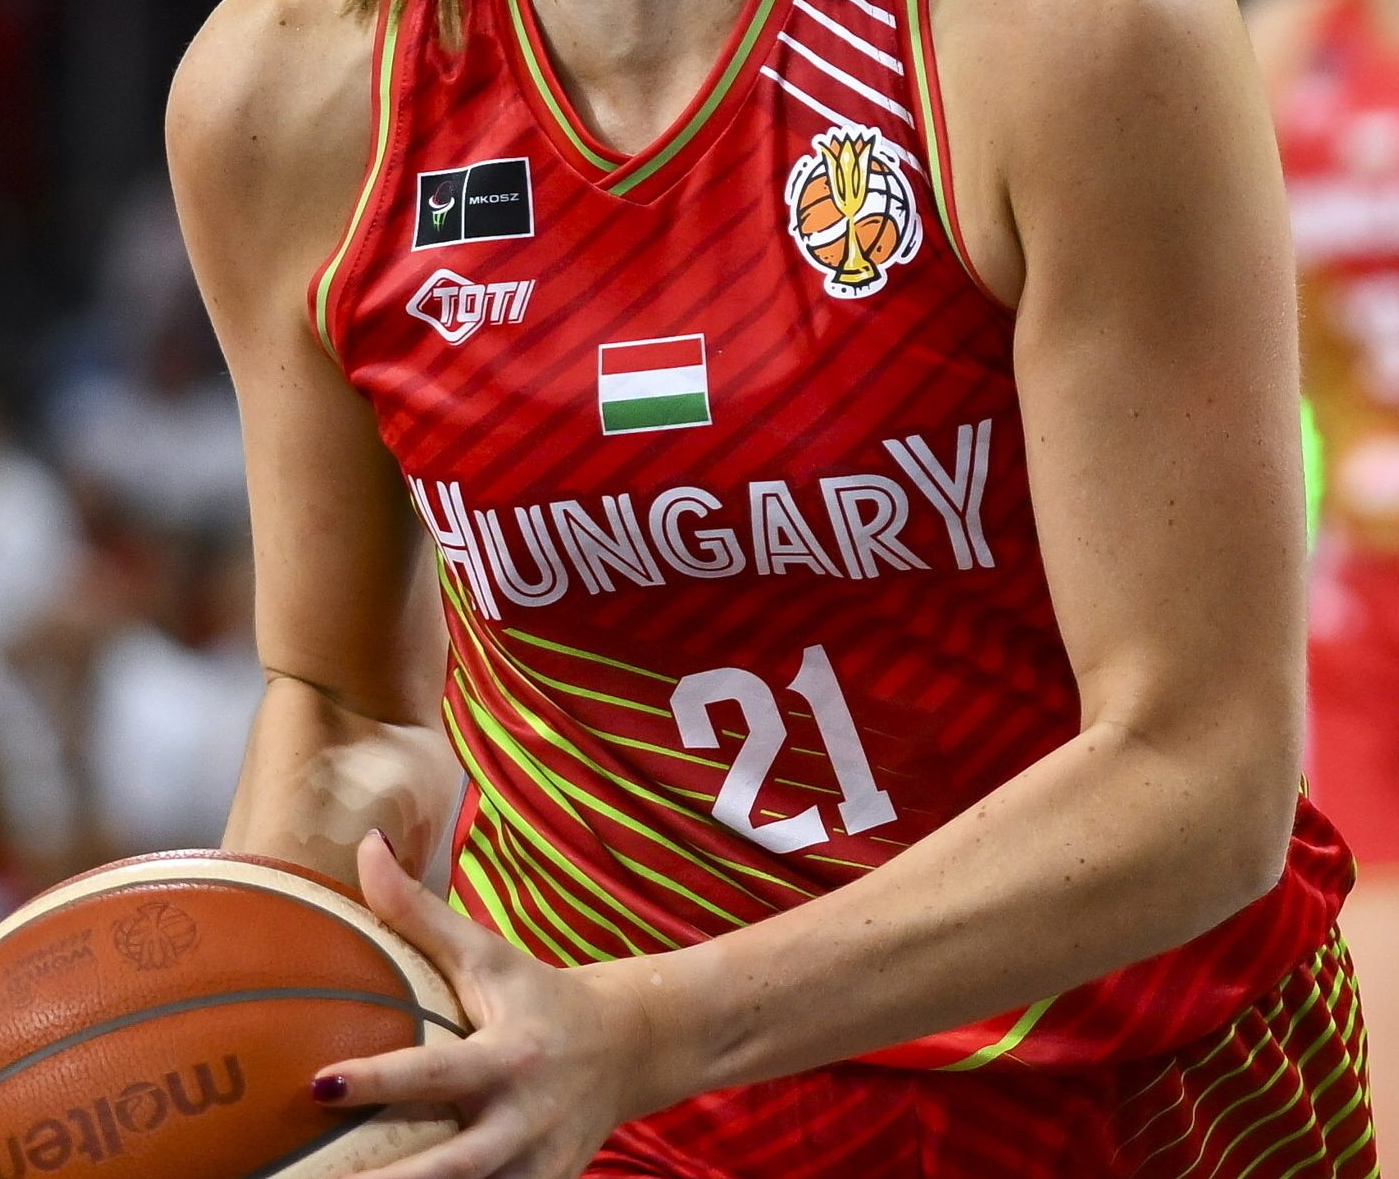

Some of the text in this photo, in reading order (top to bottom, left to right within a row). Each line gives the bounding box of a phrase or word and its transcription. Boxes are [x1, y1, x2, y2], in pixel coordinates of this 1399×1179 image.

[468, 192, 520, 206] MKOSZ
[433, 279, 536, 327] TOTI
[407, 417, 996, 622] HUNGARY
[669, 644, 898, 854] 21
